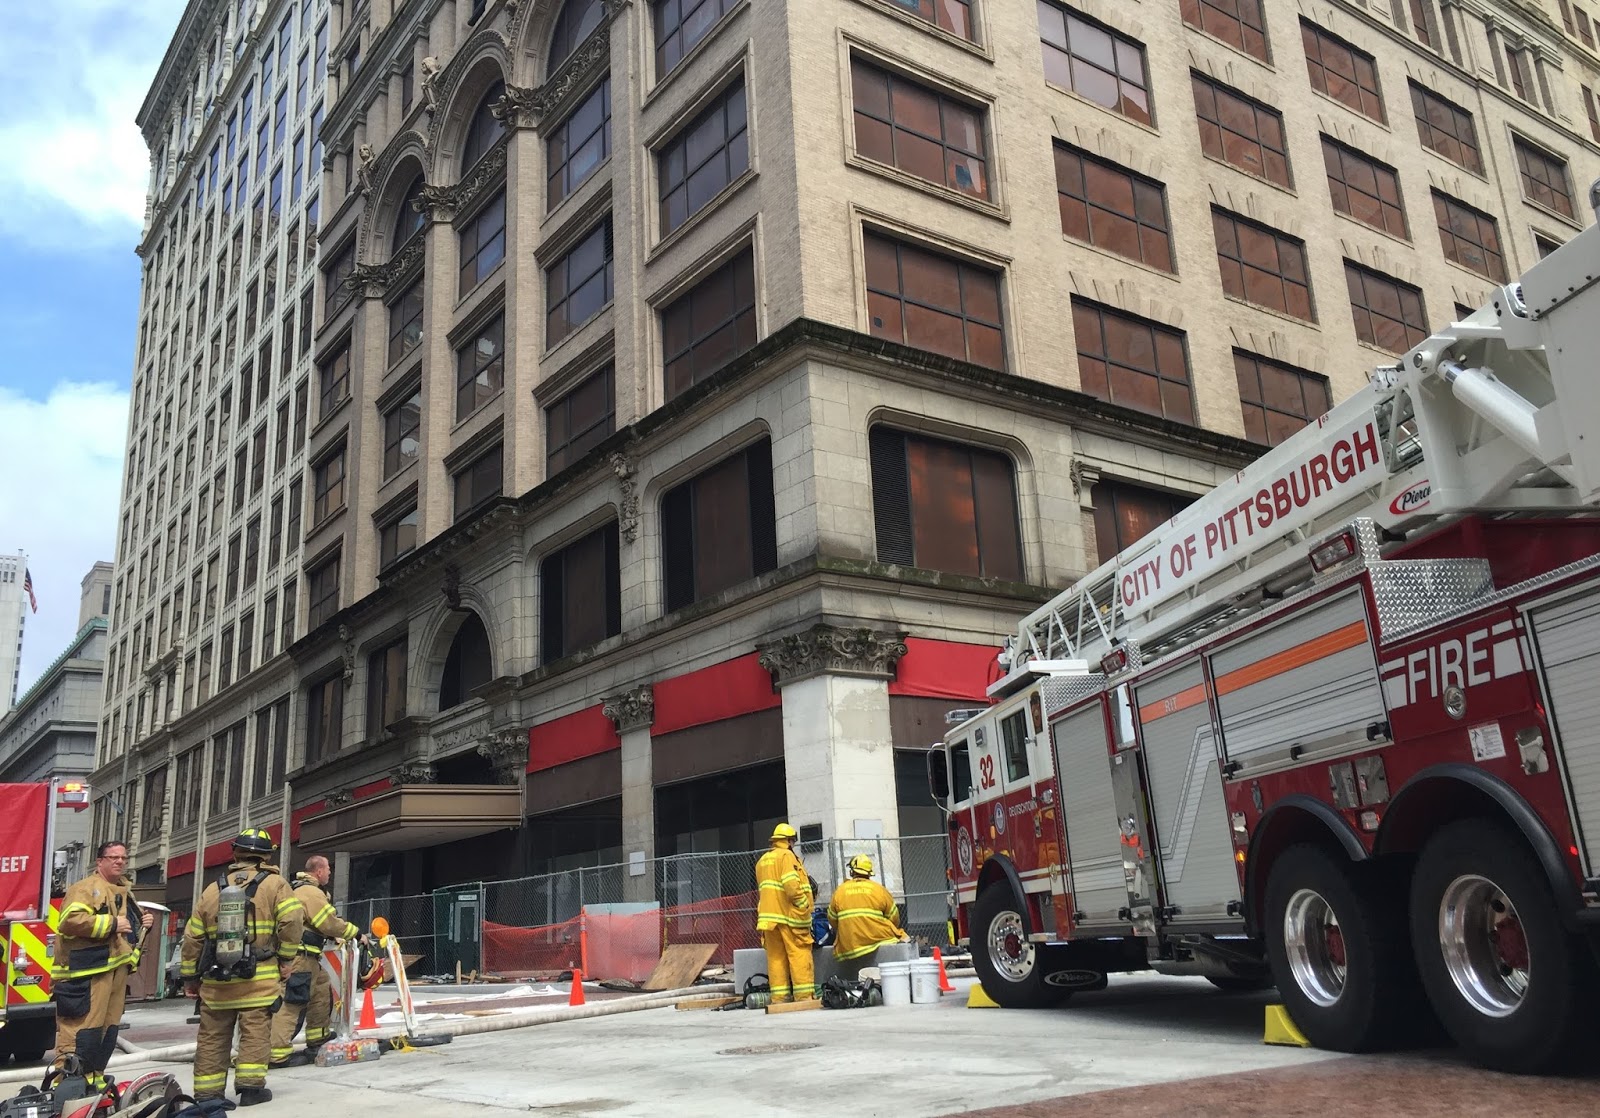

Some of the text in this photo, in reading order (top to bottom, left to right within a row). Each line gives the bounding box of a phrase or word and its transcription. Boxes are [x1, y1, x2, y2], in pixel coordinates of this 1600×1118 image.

[1402, 485, 1431, 511] Pierce
[1121, 422, 1380, 607] CITY OF PITTSBURGH
[1408, 628, 1491, 704] FIRE
[1164, 697, 1177, 713] RIT
[980, 754, 995, 790] 32
[0, 855, 30, 872] EET
